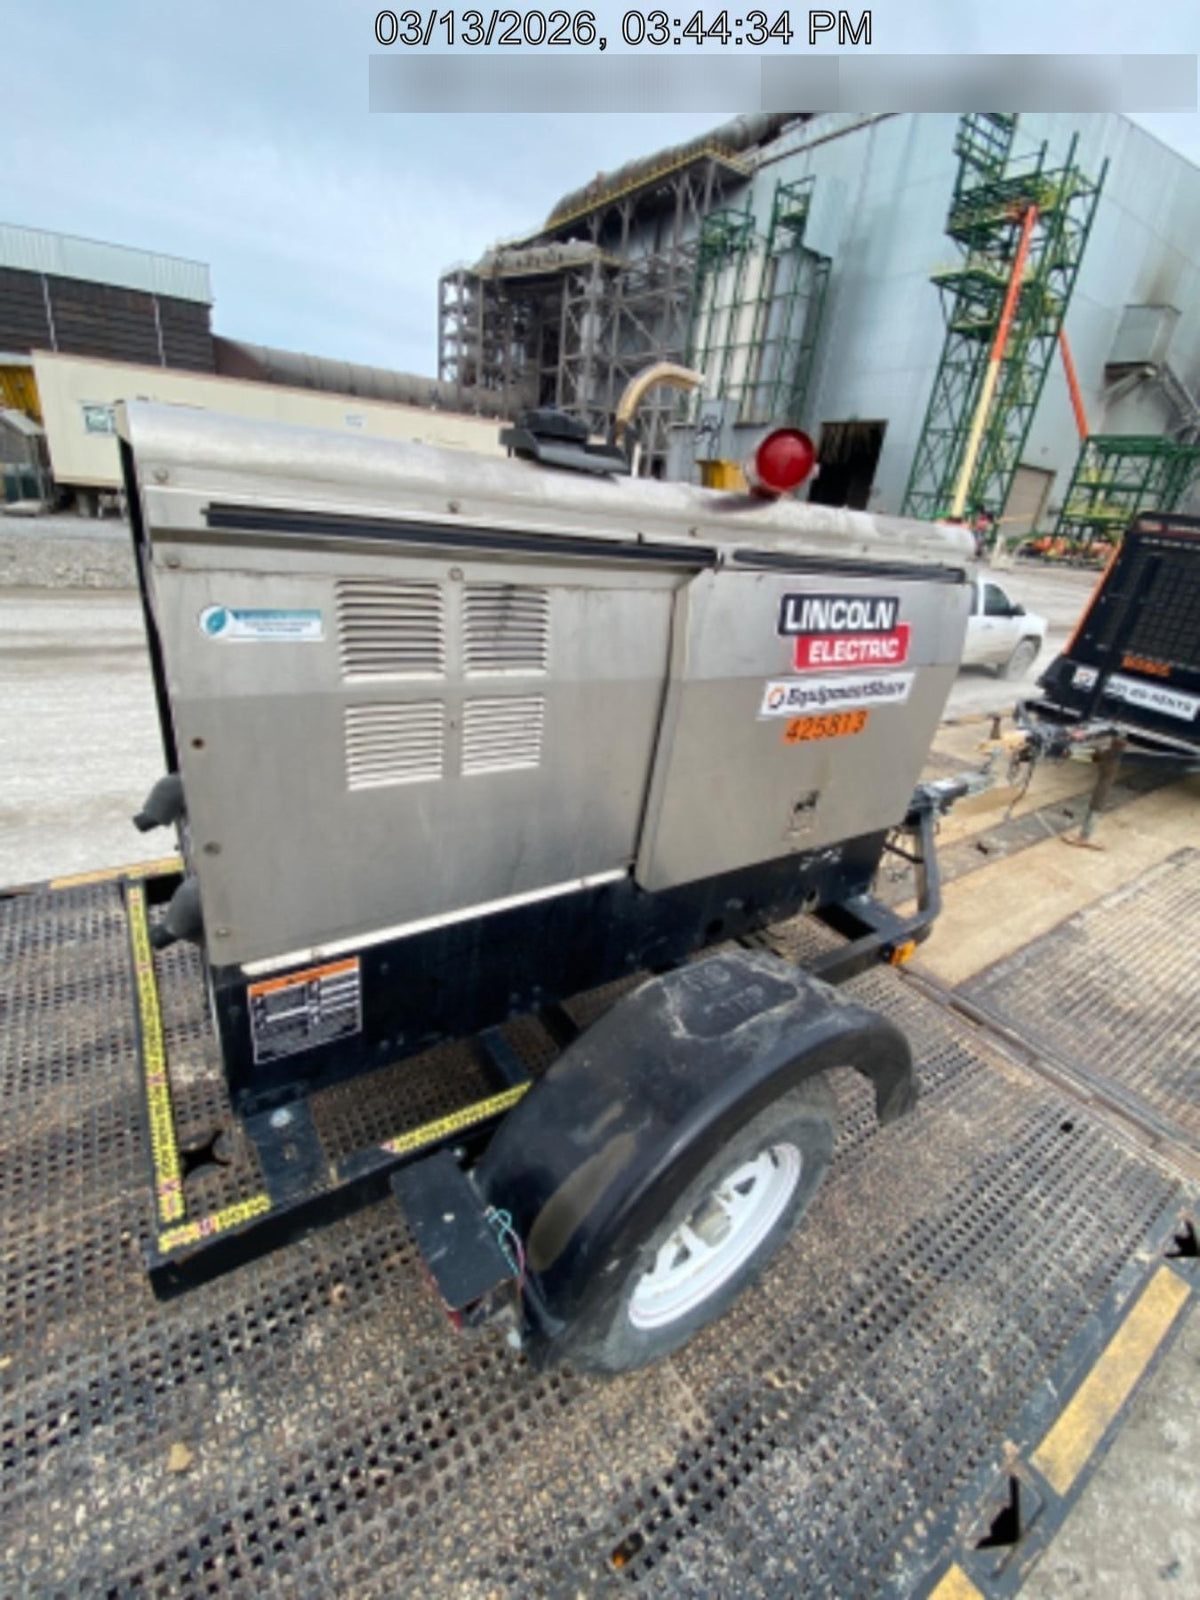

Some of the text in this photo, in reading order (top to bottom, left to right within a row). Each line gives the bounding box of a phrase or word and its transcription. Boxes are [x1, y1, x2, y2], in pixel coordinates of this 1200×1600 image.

[785, 599, 896, 631] LINCOLN
[808, 637, 900, 664] ELECTRIC
[785, 710, 868, 741] 425813
